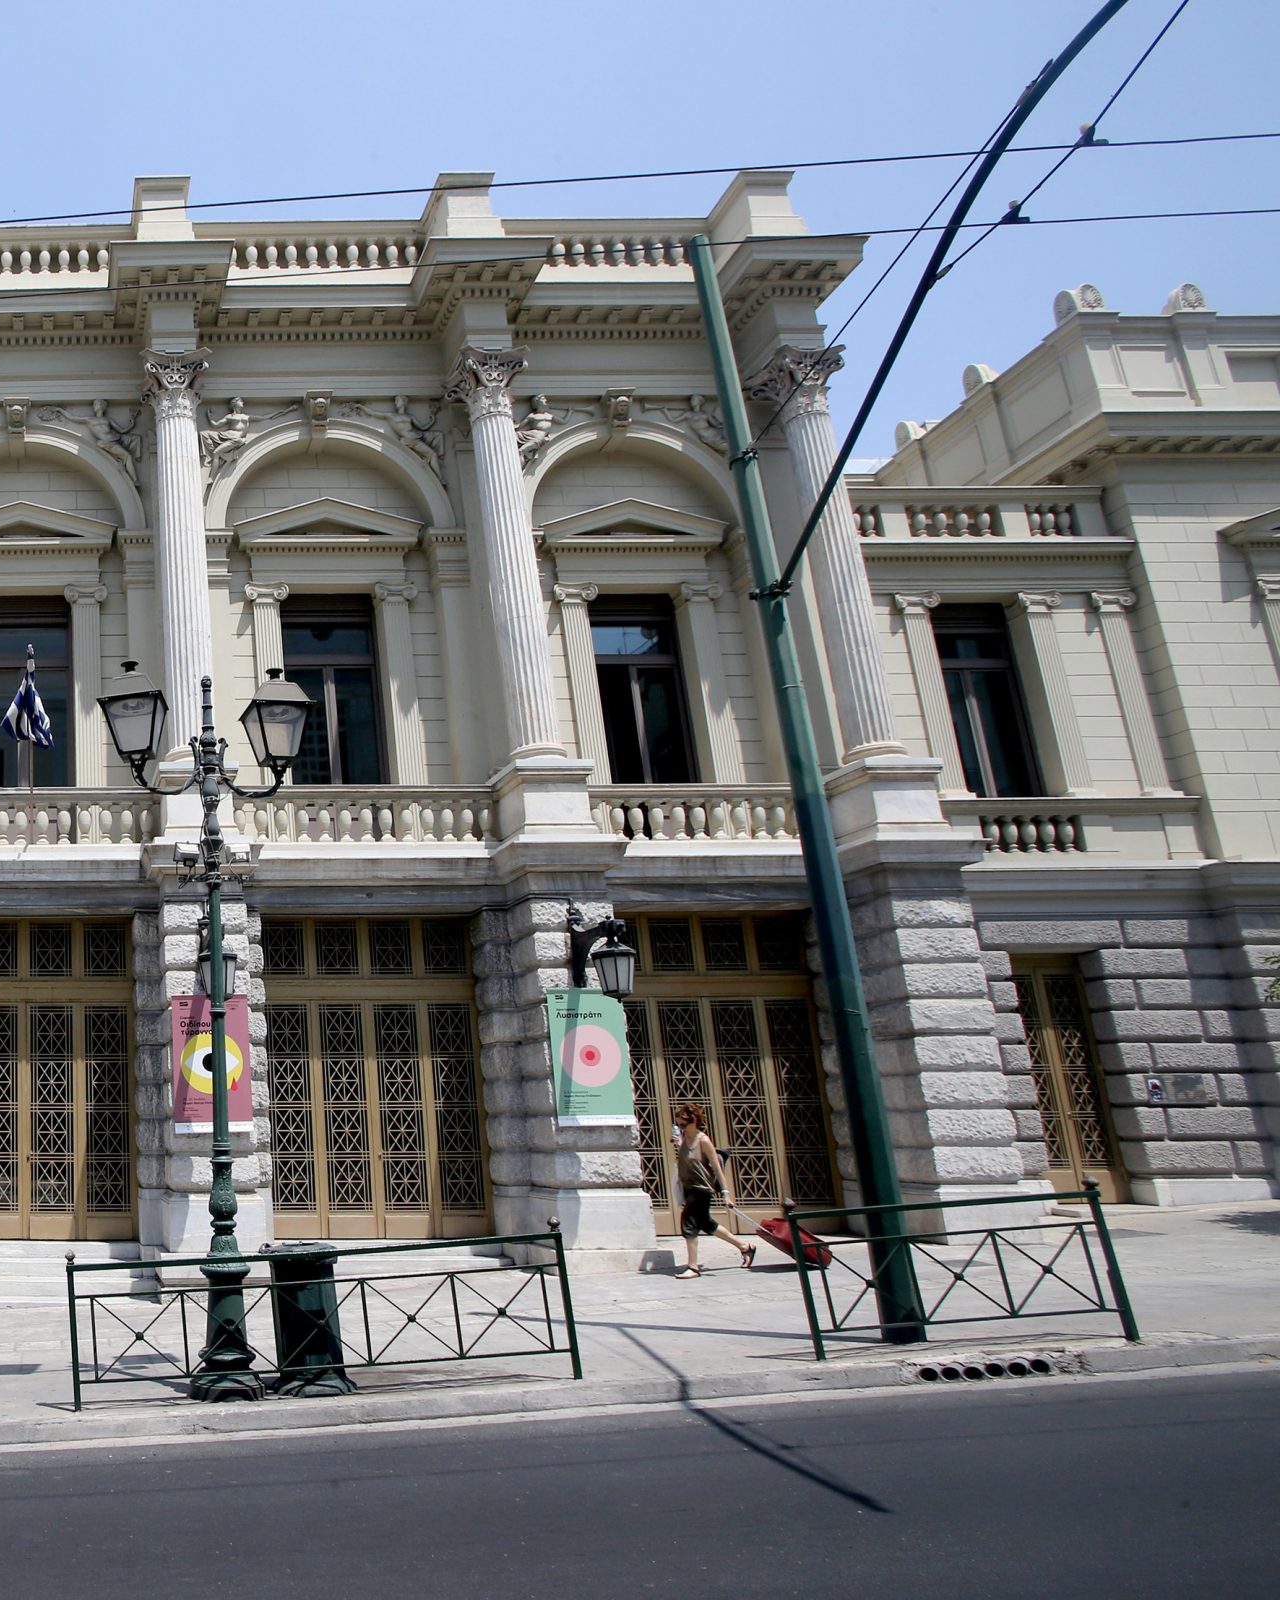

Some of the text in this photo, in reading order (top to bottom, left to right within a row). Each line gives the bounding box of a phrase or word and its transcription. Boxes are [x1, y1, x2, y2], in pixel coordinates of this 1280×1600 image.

[556, 1011, 602, 1020] Λυσιστράτη
[180, 1020, 212, 1028] Οιδίπου
[181, 1029, 214, 1037] τύραννο
